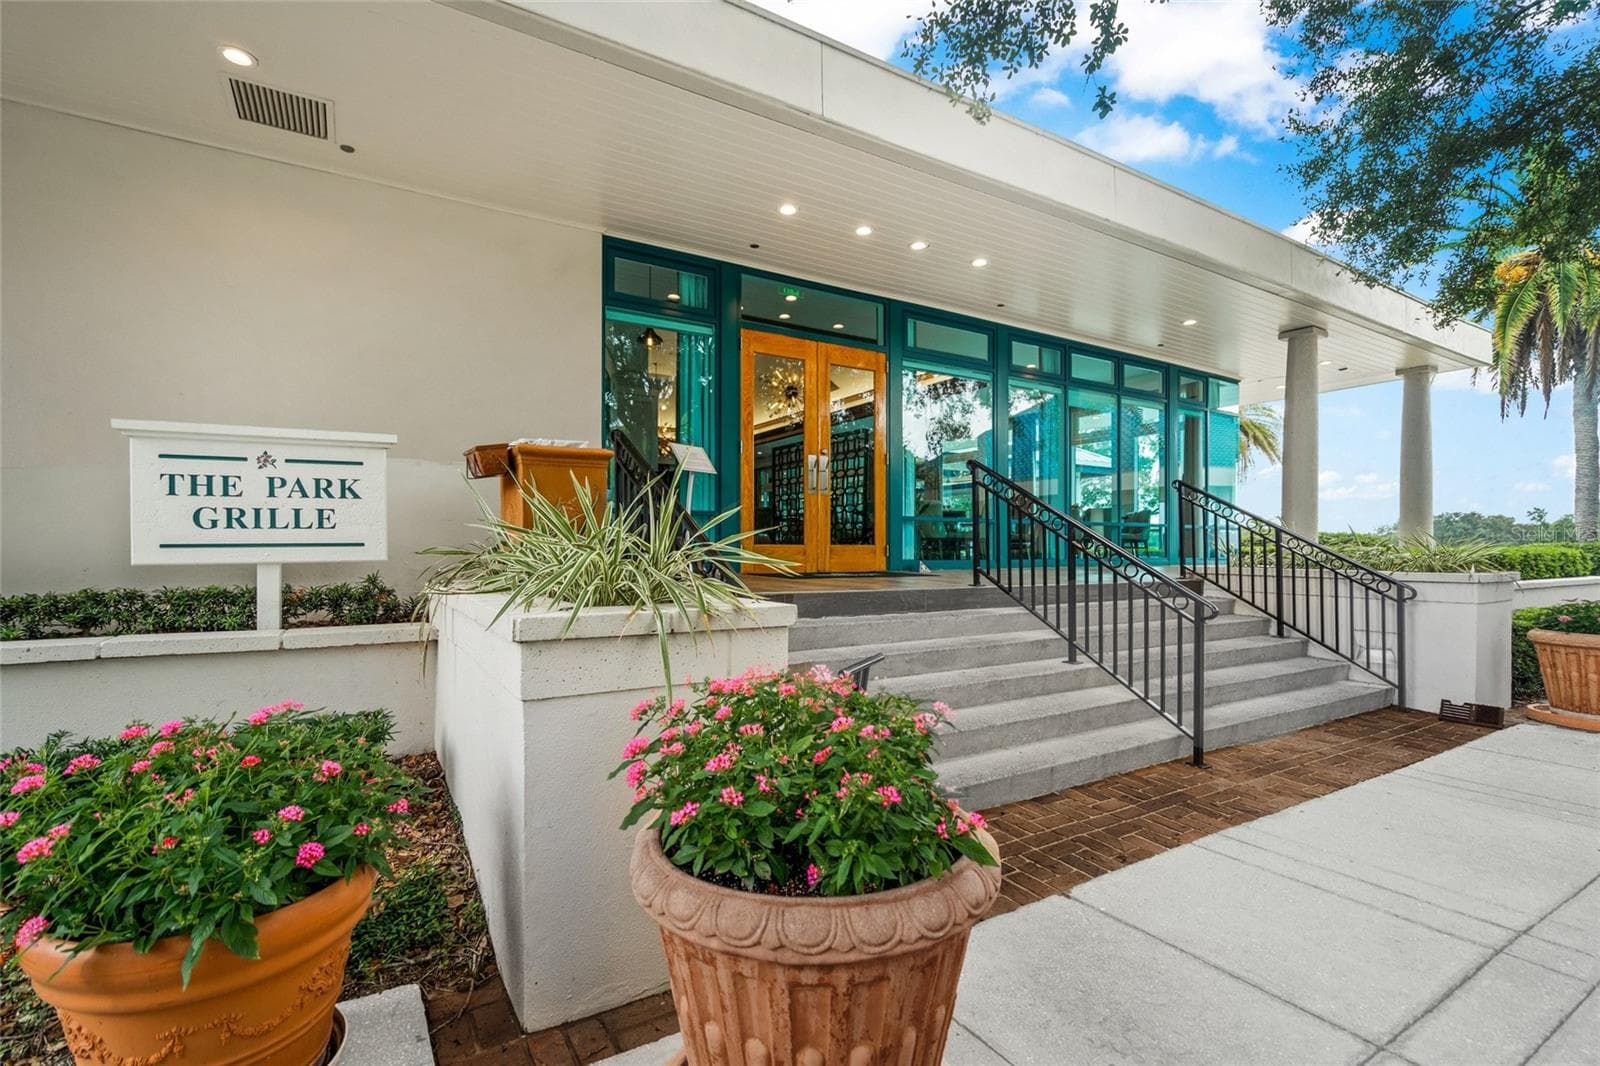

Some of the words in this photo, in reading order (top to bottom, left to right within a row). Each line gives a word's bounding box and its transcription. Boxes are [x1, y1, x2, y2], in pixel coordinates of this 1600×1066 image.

[160, 473, 243, 497] THE
[266, 476, 362, 499] PARK
[192, 506, 337, 530] GRILLE
